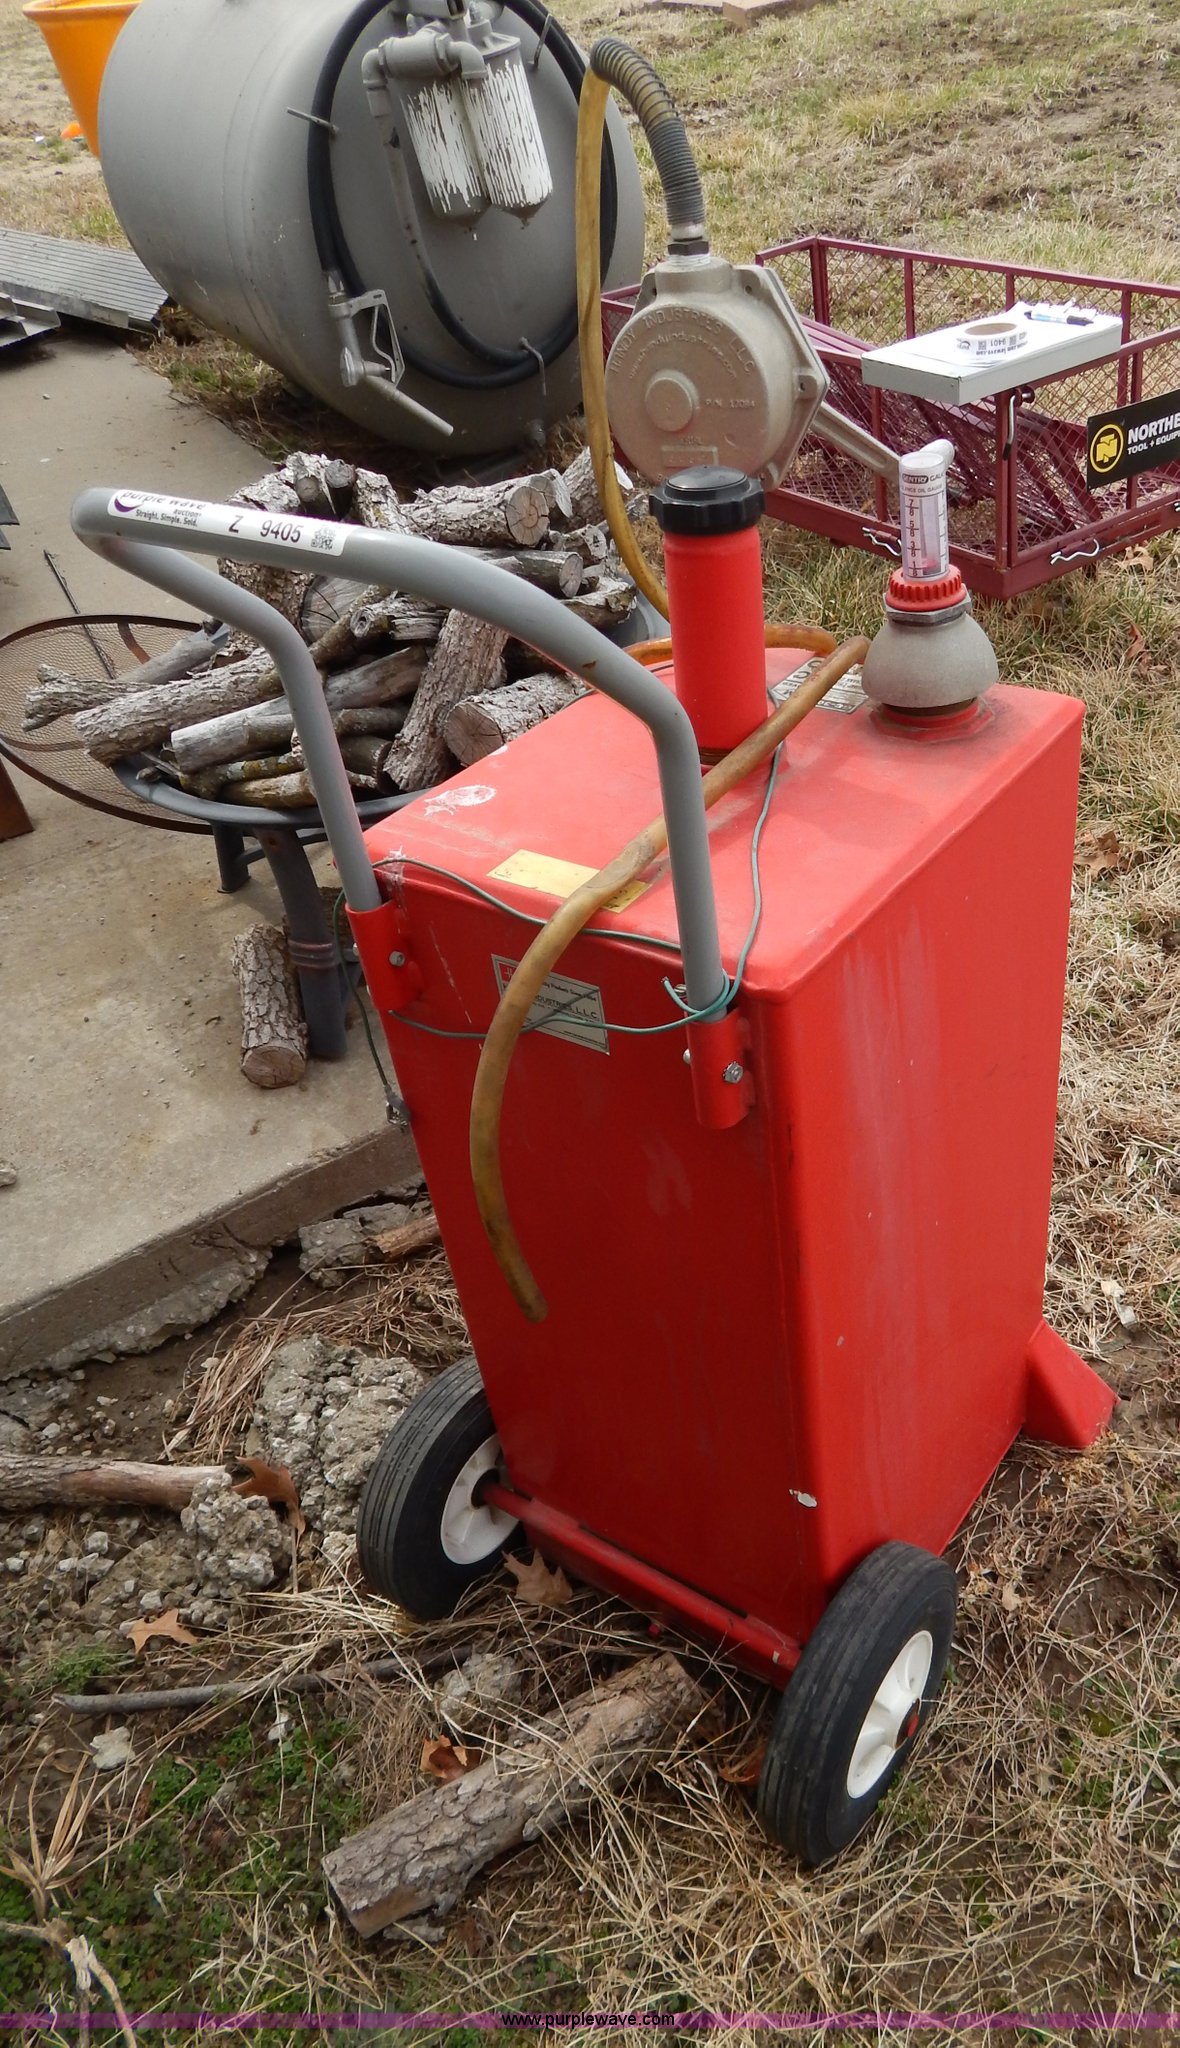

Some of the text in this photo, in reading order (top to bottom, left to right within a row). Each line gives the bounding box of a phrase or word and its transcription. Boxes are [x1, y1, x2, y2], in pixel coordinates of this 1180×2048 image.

[642, 307, 723, 335] INDUSTRIES
[729, 337, 756, 376] LLC
[1127, 412, 1180, 445] NORTHE
[1127, 442, 1149, 455] TOOL
[903, 474, 928, 483] SENTRY
[135, 508, 198, 527] Straight. Simple. Sold.
[228, 514, 241, 534] Z
[260, 519, 305, 543] 9405
